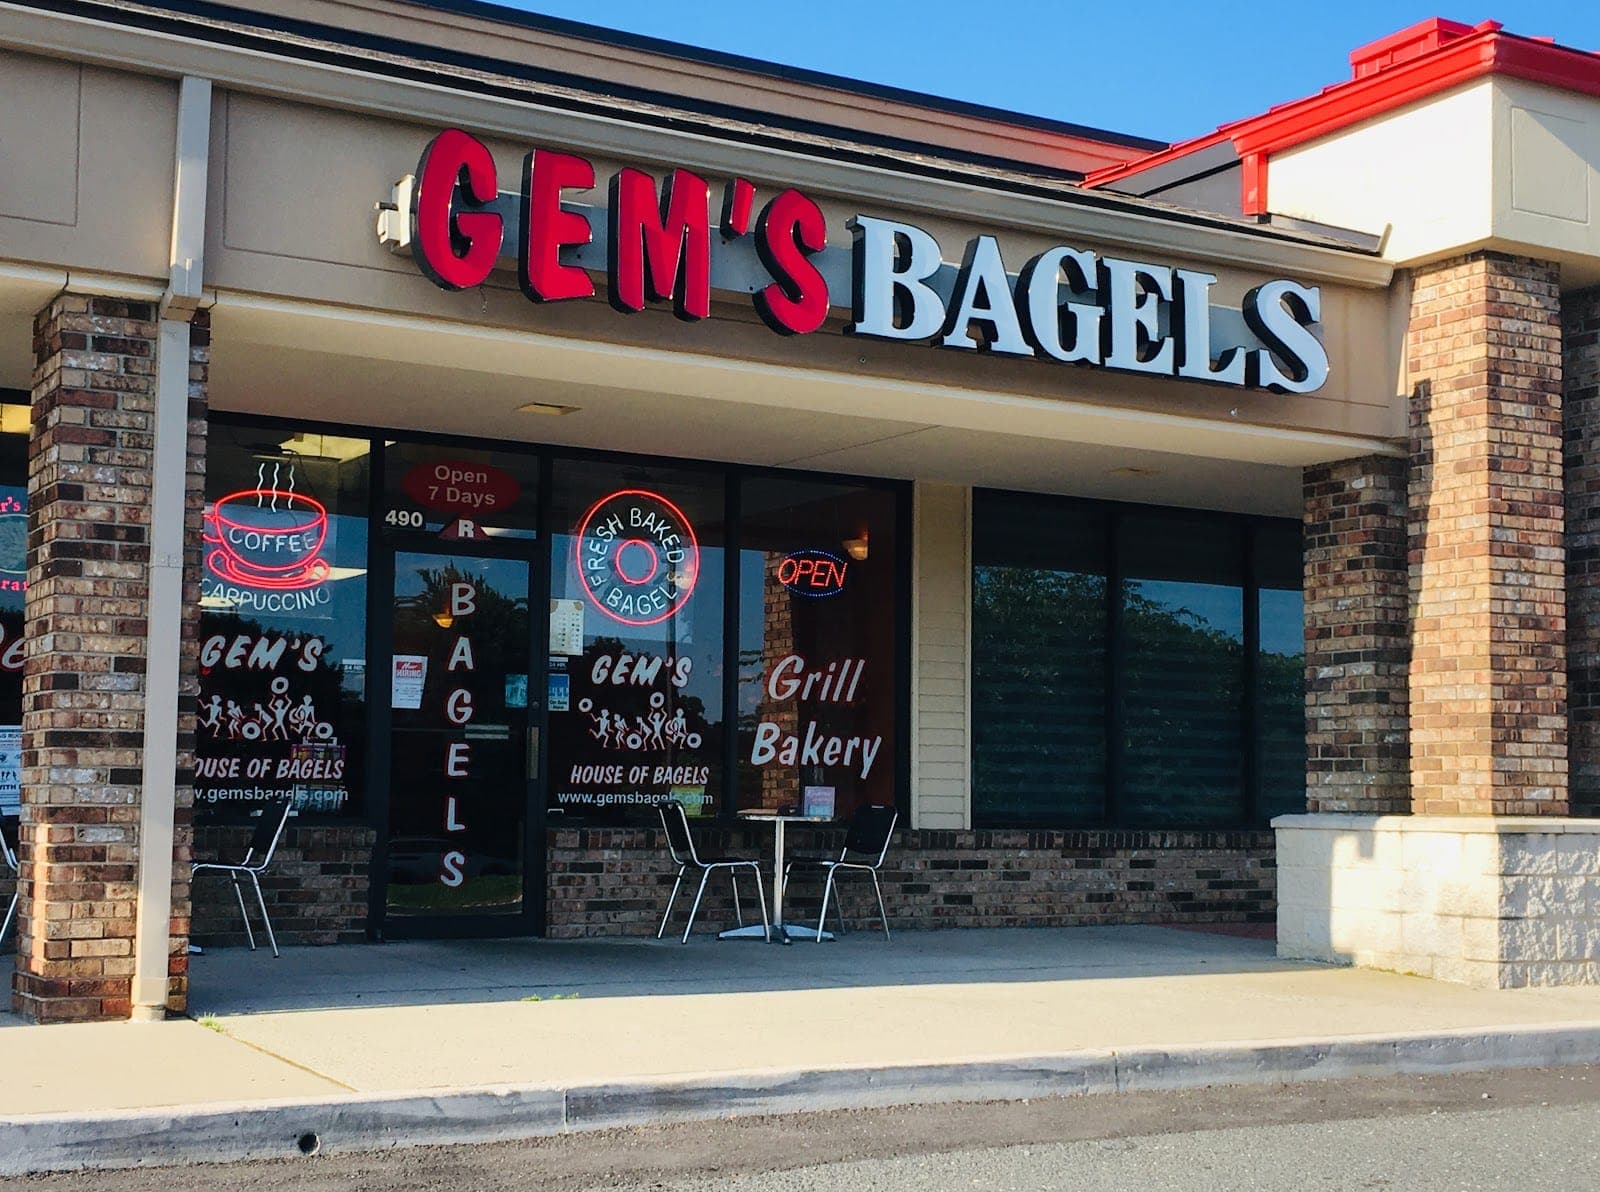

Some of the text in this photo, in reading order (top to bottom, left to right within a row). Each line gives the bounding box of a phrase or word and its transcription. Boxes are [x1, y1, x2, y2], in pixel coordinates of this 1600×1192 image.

[412, 128, 1330, 394] GEM'S BAGELS
[434, 465, 488, 485] Open
[428, 486, 496, 507] 7 Days
[385, 510, 423, 527] 490
[458, 519, 474, 538] R
[229, 527, 317, 553] COFFEE
[587, 507, 685, 587] FRESH BAKED
[777, 558, 848, 588] OPEN
[199, 578, 331, 612] CAPPUCCINO
[200, 634, 324, 673] GEM'S
[591, 654, 693, 690] GEM'S
[767, 654, 866, 702] Grill
[440, 582, 477, 888] BAGELS
[750, 720, 882, 780] Bakery
[246, 758, 272, 779] OF
[276, 759, 345, 779] BAGELS
[570, 765, 710, 785] HOUSE OF BAGELS
